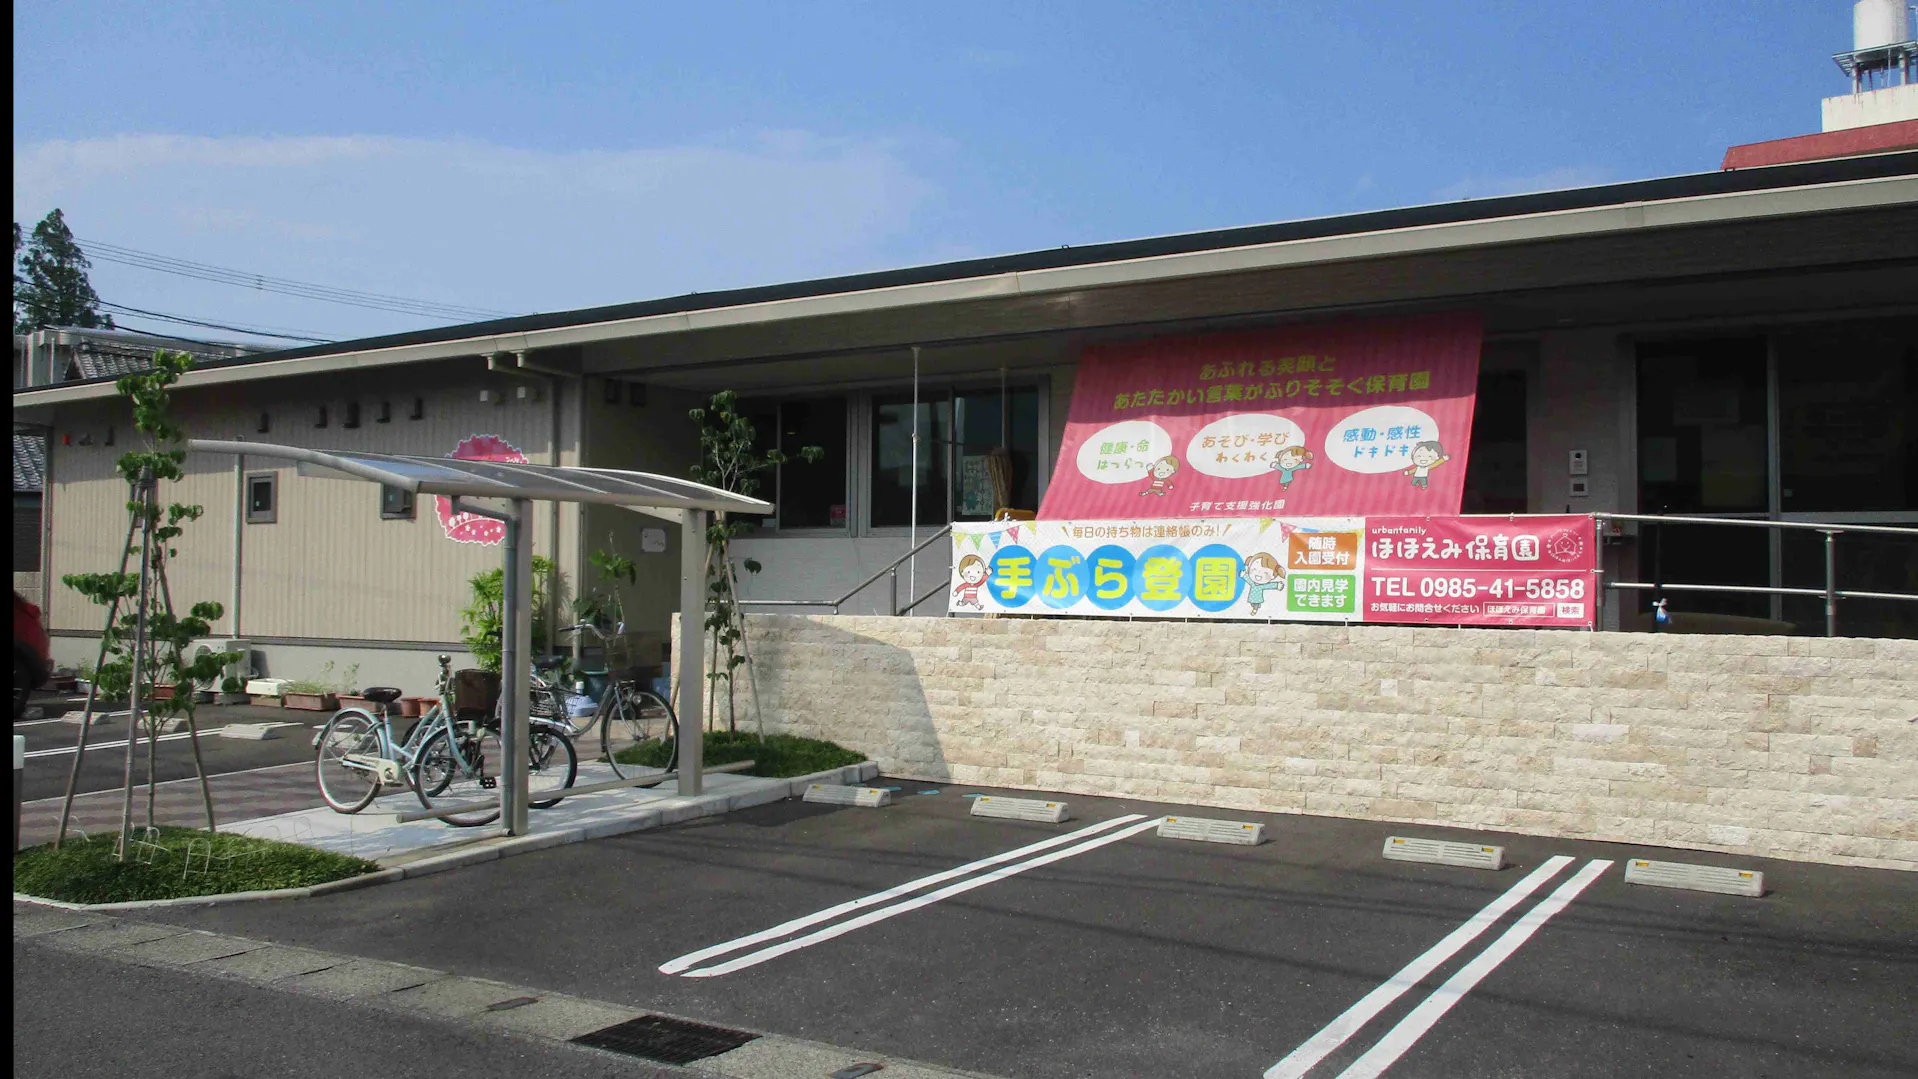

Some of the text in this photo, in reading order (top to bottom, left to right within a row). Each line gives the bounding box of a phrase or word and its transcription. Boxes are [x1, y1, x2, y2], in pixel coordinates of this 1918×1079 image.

[1200, 355, 1336, 380] あふれる笑顔と
[1201, 431, 1290, 449] あそび・学び
[1343, 425, 1422, 442] 感動・感性
[1099, 439, 1150, 456] 健康・命
[1354, 444, 1409, 458] ドキドキ
[1215, 451, 1268, 463] わくわく
[1097, 459, 1145, 471] はつらつ
[1189, 499, 1286, 512] 子育て支援強化園
[1371, 525, 1427, 536] urbanfamily
[1308, 536, 1337, 550] 随時
[1371, 533, 1540, 561] ほほえみ保育園
[1294, 551, 1350, 566] 入園受付
[994, 555, 1238, 601] 手ぶら登園
[1293, 578, 1349, 593] 園内見学
[1371, 577, 1585, 600] TEL 0985-41-5858
[1294, 594, 1348, 608] できます
[1370, 602, 1480, 614] お気軽にお問合せください
[1486, 605, 1547, 615] ほほえみ保育園
[1561, 605, 1581, 615] 検索
